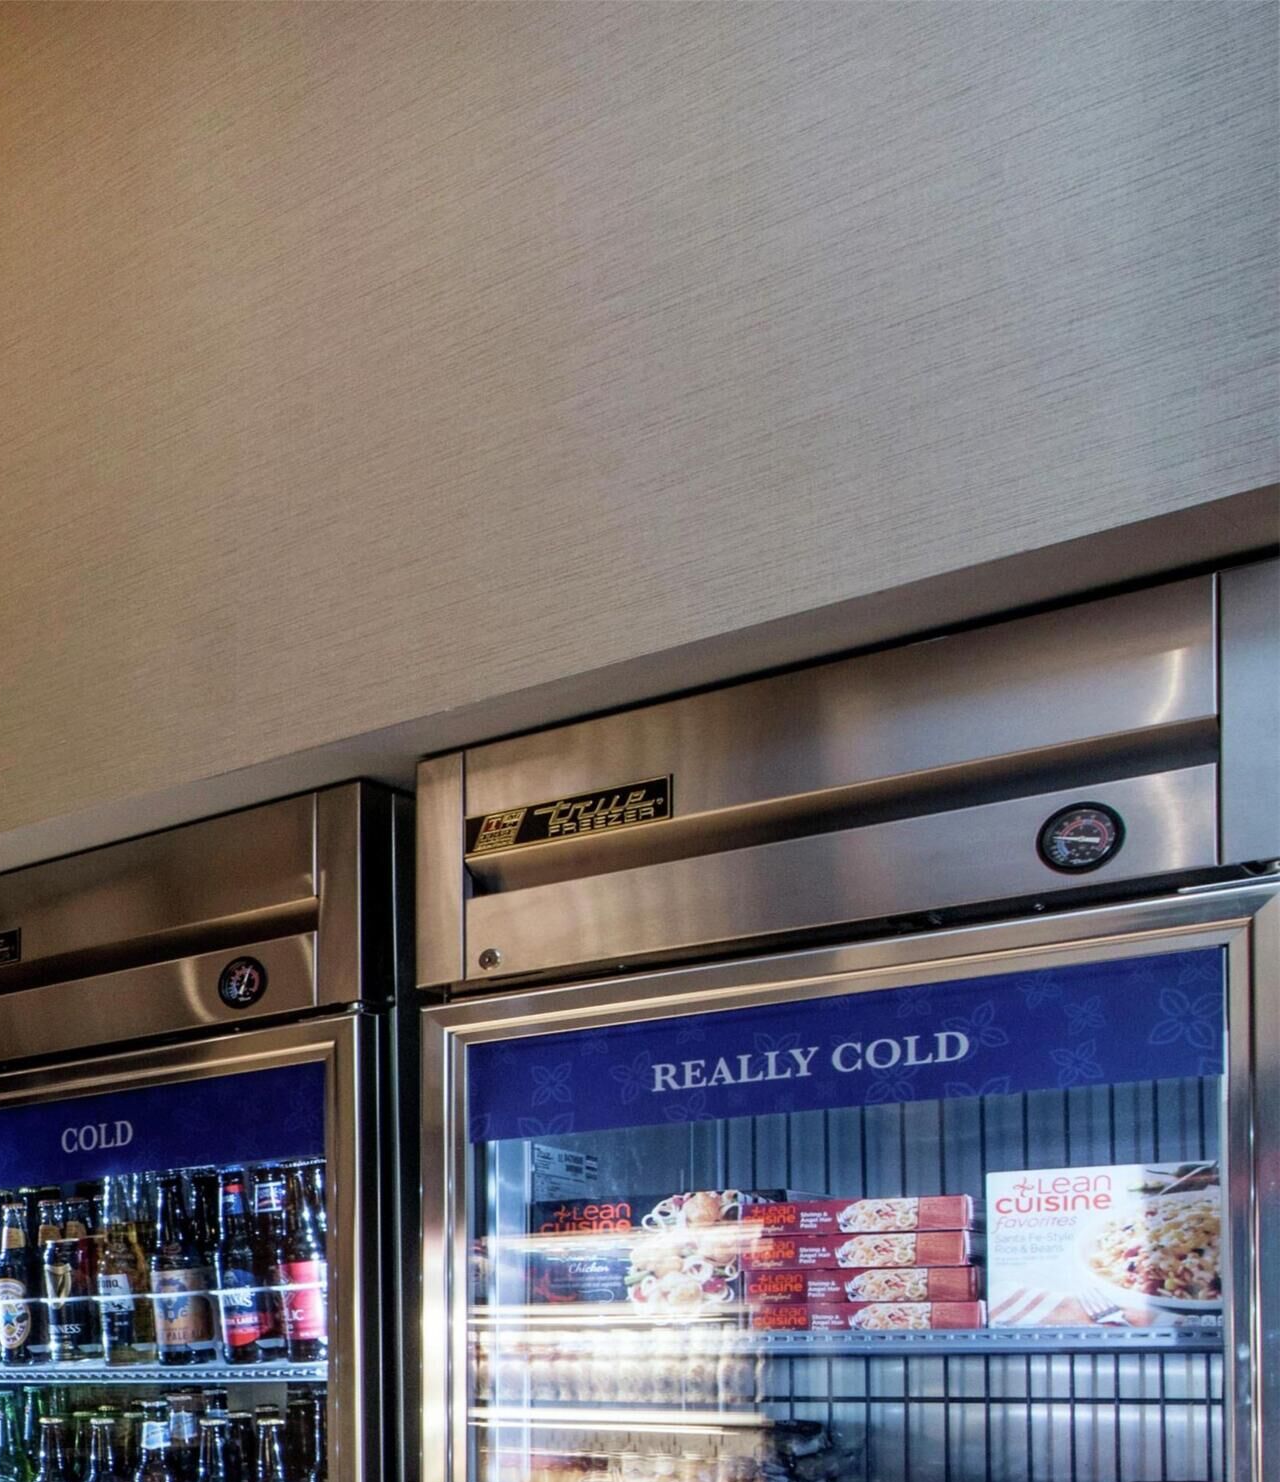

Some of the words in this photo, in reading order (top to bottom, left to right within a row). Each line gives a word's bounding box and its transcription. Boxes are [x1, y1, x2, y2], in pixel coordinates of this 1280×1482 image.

[548, 807, 655, 837] FREEZER
[650, 1045, 821, 1093] REALLY
[830, 1031, 971, 1074] COLD
[61, 1120, 134, 1153] COLD
[1038, 1174, 1112, 1194] Lean
[573, 1202, 631, 1220] Lean
[995, 1193, 1112, 1214] cuisine
[991, 1215, 1077, 1234] favorites
